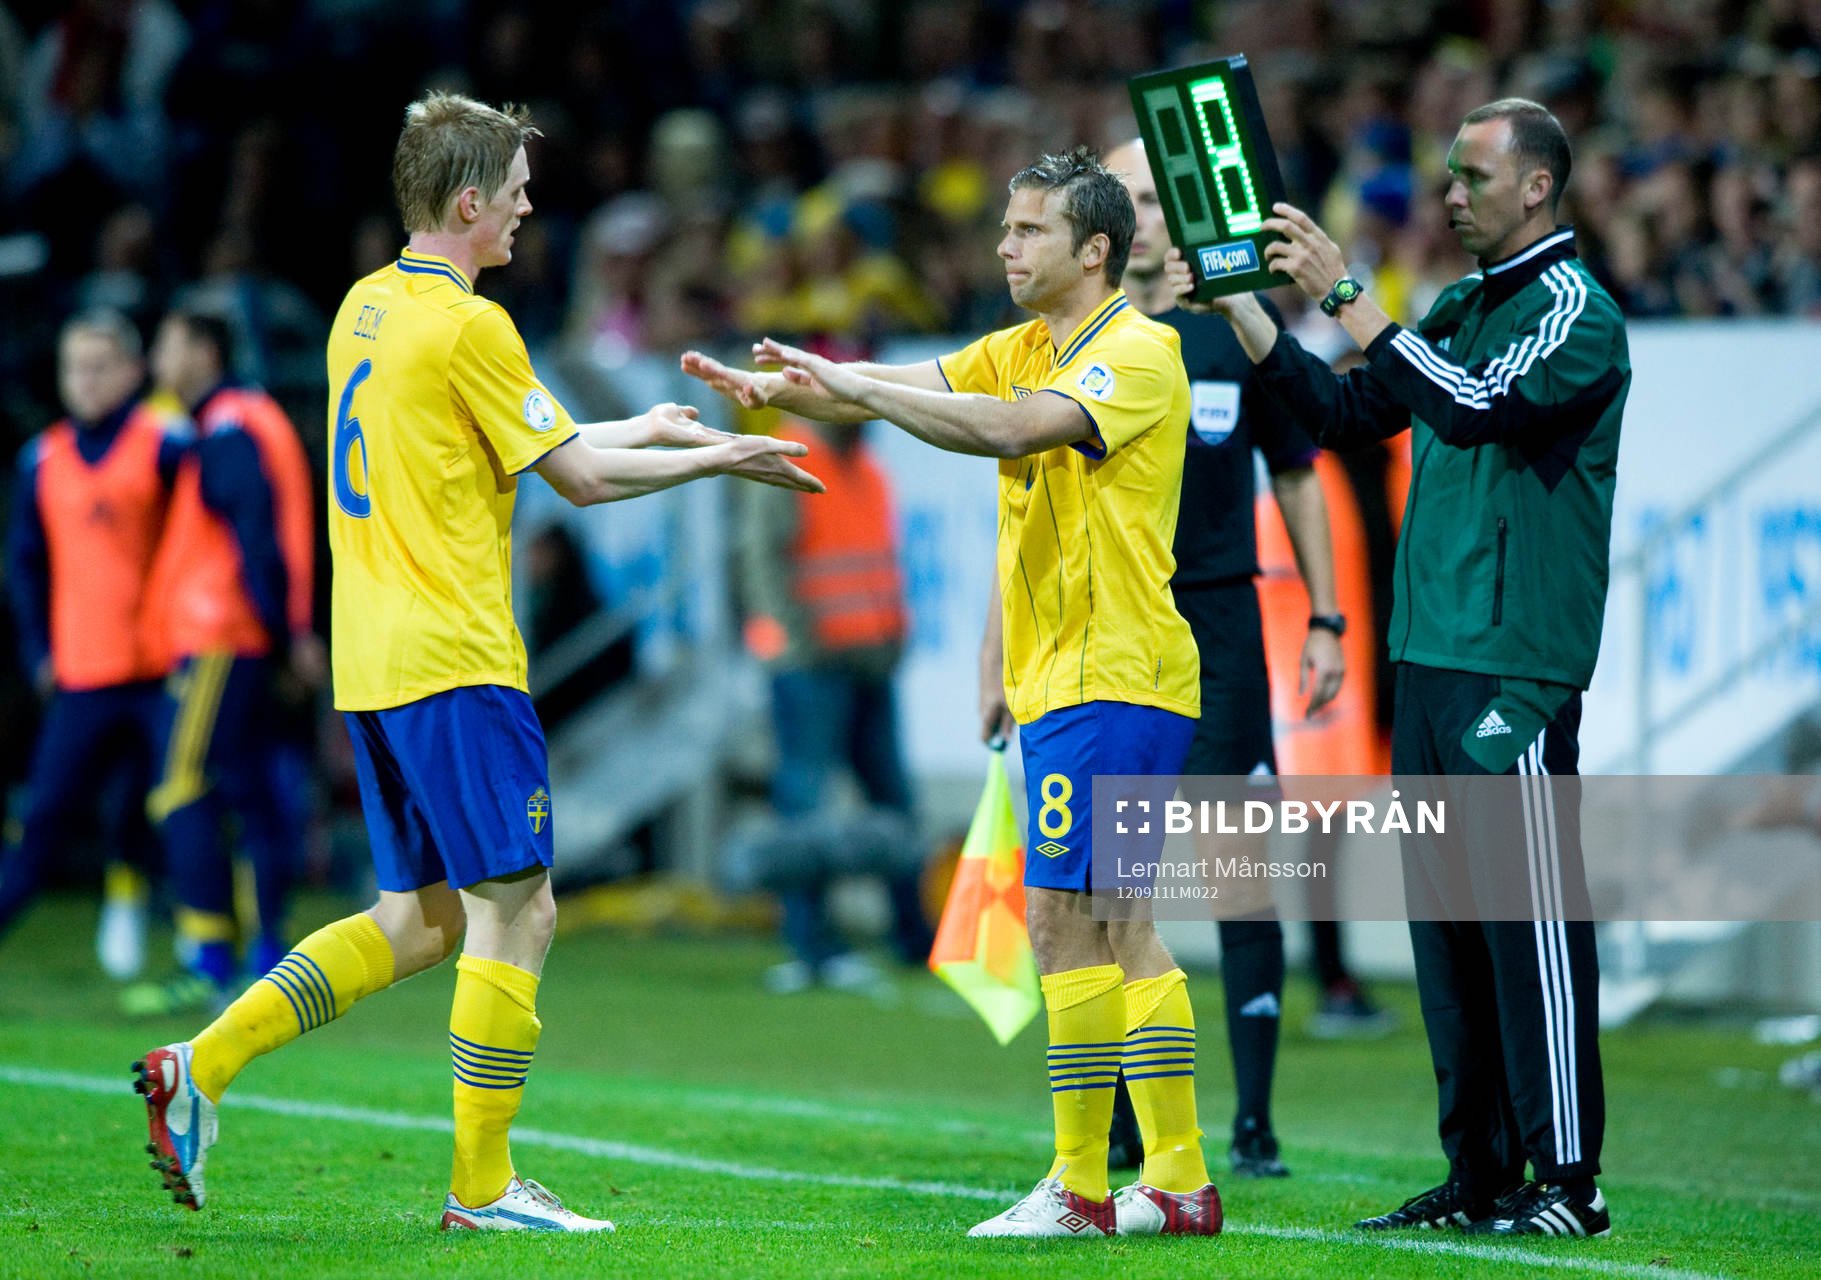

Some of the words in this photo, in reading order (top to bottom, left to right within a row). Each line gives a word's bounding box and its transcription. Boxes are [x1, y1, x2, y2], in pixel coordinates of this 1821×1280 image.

[1188, 76, 1262, 236] 8
[353, 305, 387, 340] ELM
[333, 358, 372, 519] 6
[1476, 725, 1512, 738] adidas
[1038, 773, 1073, 839] 8
